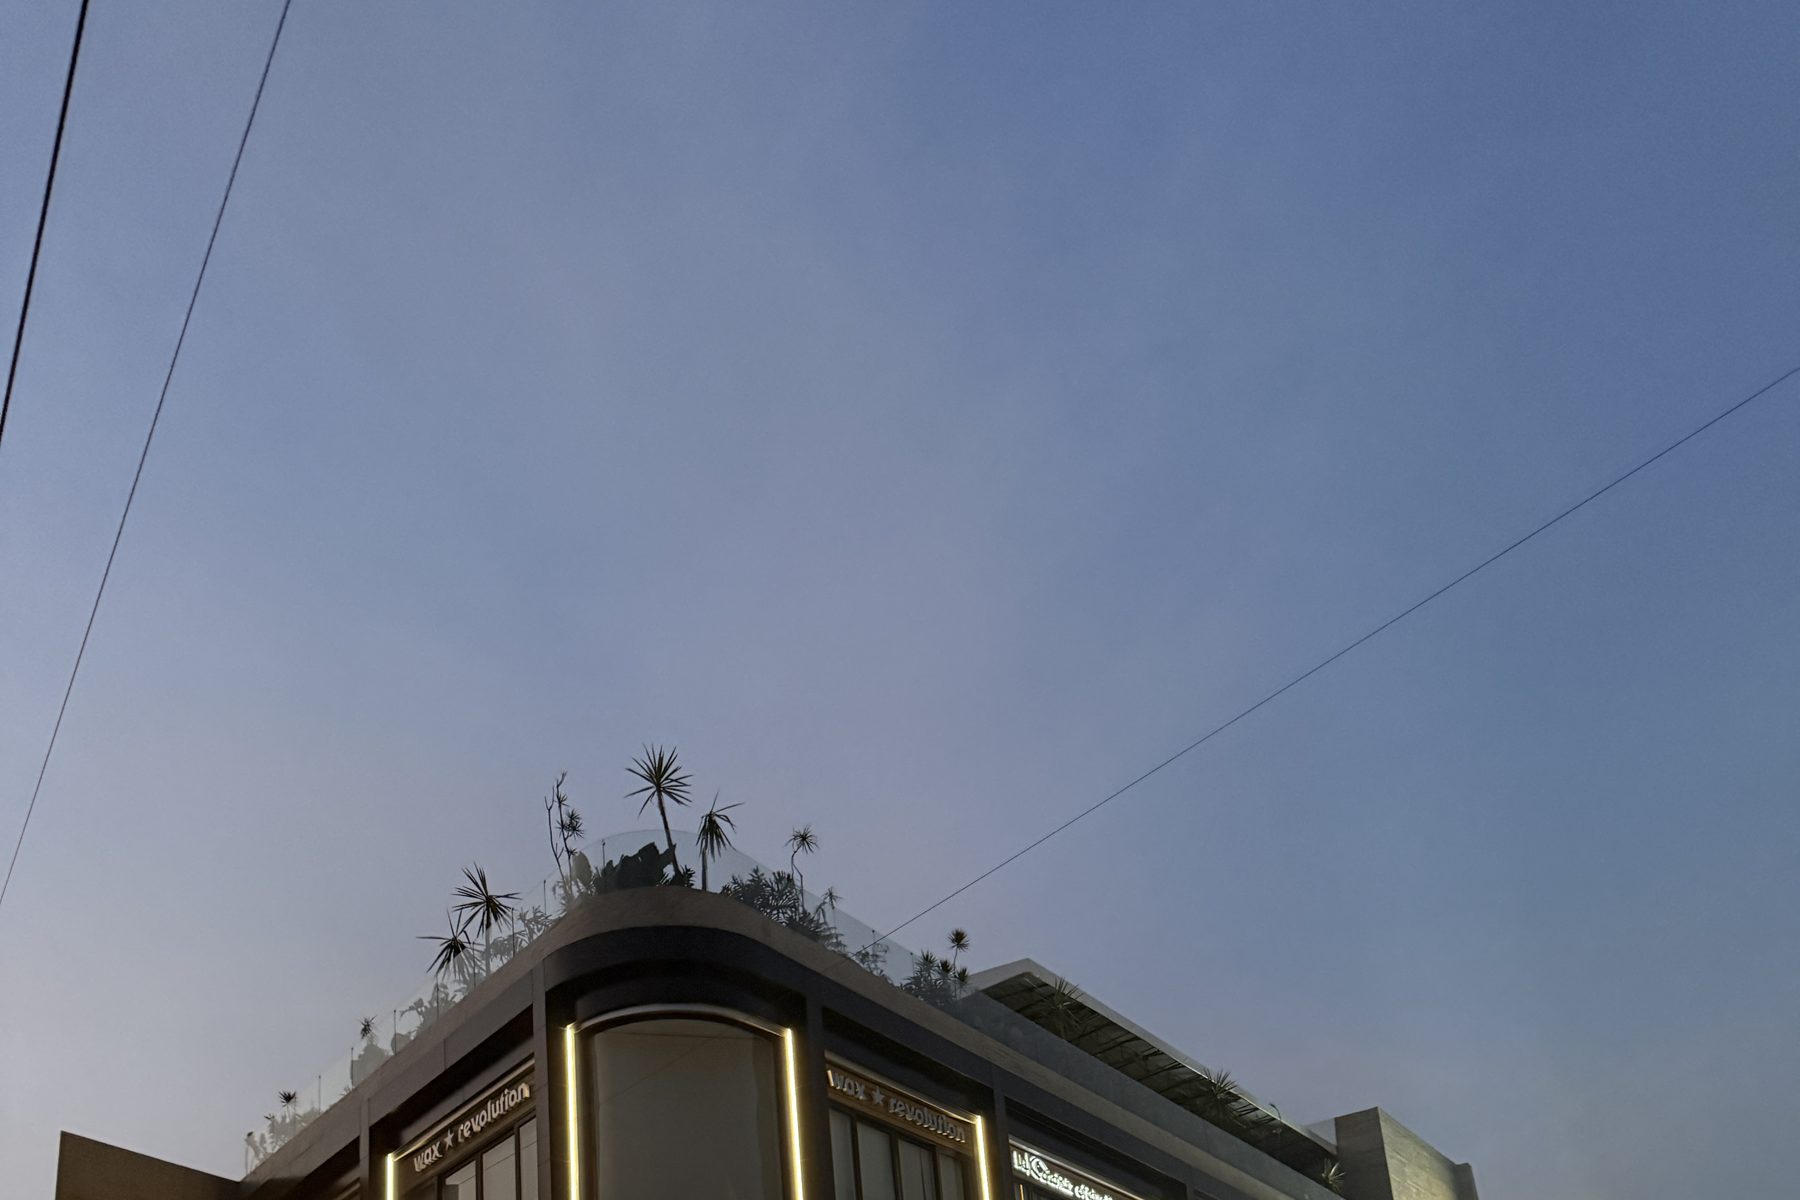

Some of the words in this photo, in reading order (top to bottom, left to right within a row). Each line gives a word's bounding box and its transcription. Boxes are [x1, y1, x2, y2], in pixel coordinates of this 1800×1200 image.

[414, 1141, 443, 1172] wax
[457, 1082, 530, 1143] revolution
[826, 1070, 866, 1100] wax
[888, 1097, 966, 1143] revolution
